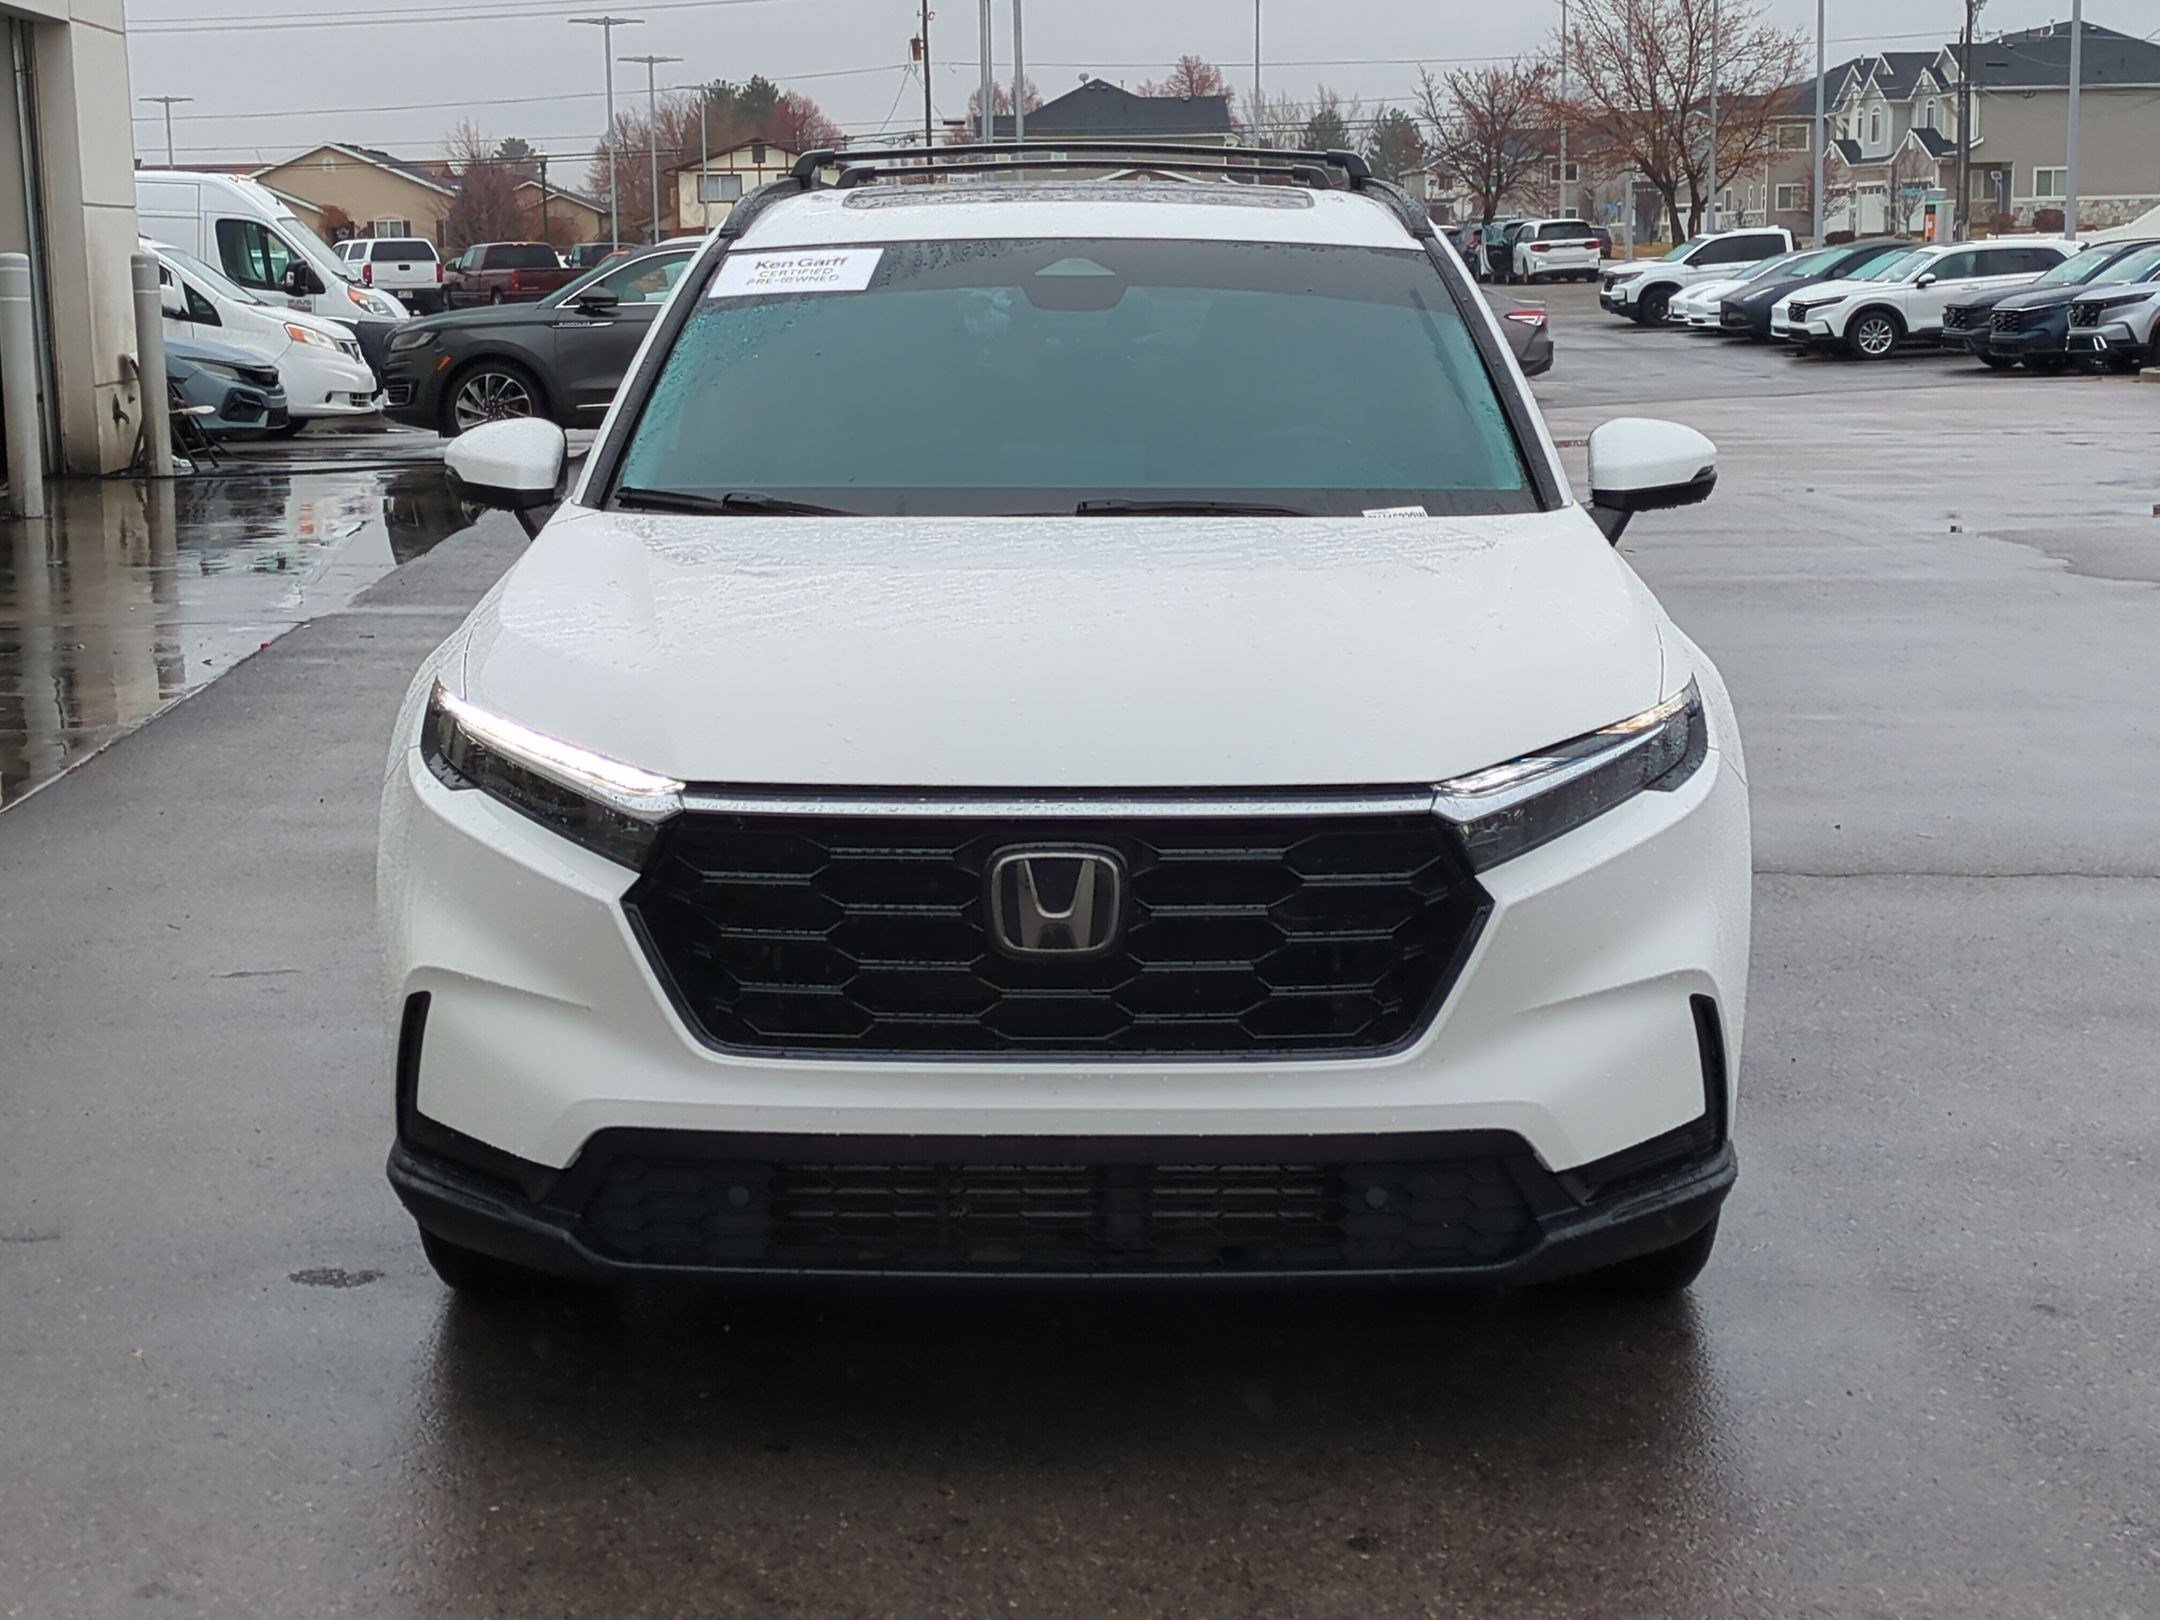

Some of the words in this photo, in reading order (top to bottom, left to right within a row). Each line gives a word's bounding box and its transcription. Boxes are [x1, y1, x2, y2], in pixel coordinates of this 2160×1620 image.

[754, 260, 794, 270] Ken
[797, 256, 848, 268] Garff
[759, 267, 834, 278] CERTIFIED
